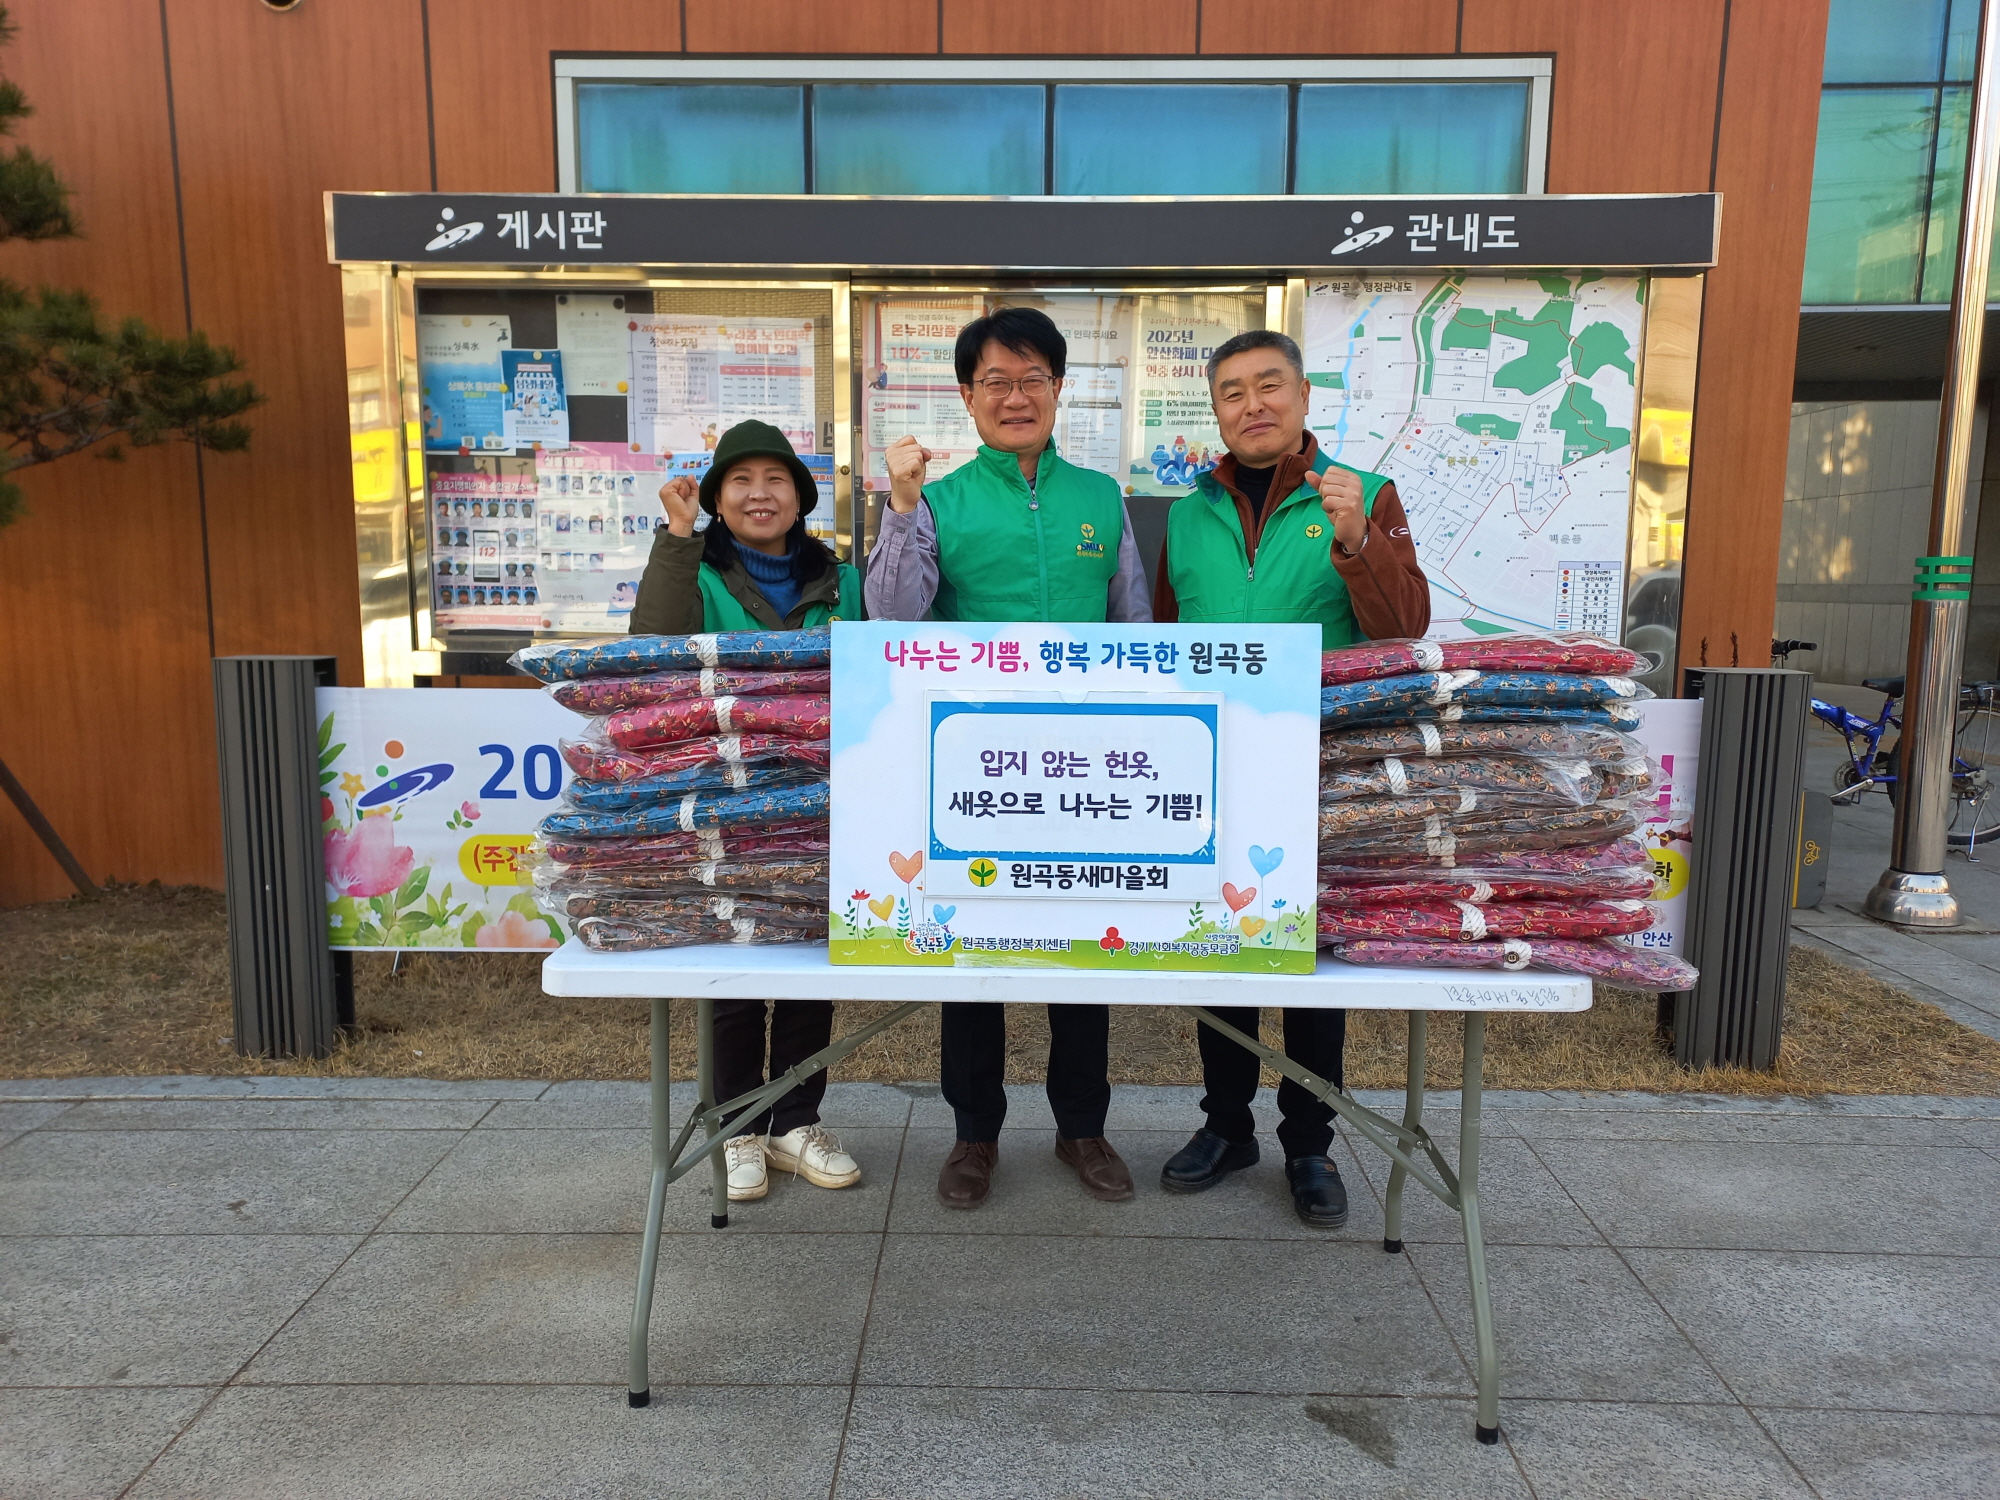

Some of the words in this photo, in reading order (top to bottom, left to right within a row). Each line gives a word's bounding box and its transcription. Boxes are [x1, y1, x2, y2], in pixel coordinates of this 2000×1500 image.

[497, 210, 607, 250] 게시판
[1405, 213, 1520, 253] 관내도
[1364, 282, 1413, 293] 행정관내도
[1074, 330, 1118, 339] 연락주세요
[1147, 330, 1194, 344] 2025년
[1147, 346, 1198, 360] 안산화폐
[1172, 365, 1194, 378] 상시
[479, 546, 497, 557] 112
[885, 641, 961, 672] 나누는
[971, 641, 1029, 673] 기쁨,
[1039, 640, 1091, 674] 행복
[1100, 641, 1180, 675] 가득한
[1188, 642, 1268, 676] 원곡동
[980, 749, 1028, 778] 입지
[1041, 750, 1091, 779] 않는
[1104, 750, 1159, 781] 헌옷,
[948, 790, 1046, 819] 새옷으로
[1059, 792, 1132, 820] 나누는
[1145, 793, 1203, 822] 기쁨!
[1009, 864, 1170, 891] 원곡동새마을회
[914, 936, 944, 953] 원곡동
[961, 936, 1072, 952] 원곡동행정복지센터
[1642, 932, 1673, 947] 안산
[1129, 941, 1149, 956] 경기
[1152, 941, 1239, 957] 사회복지공동모금회
